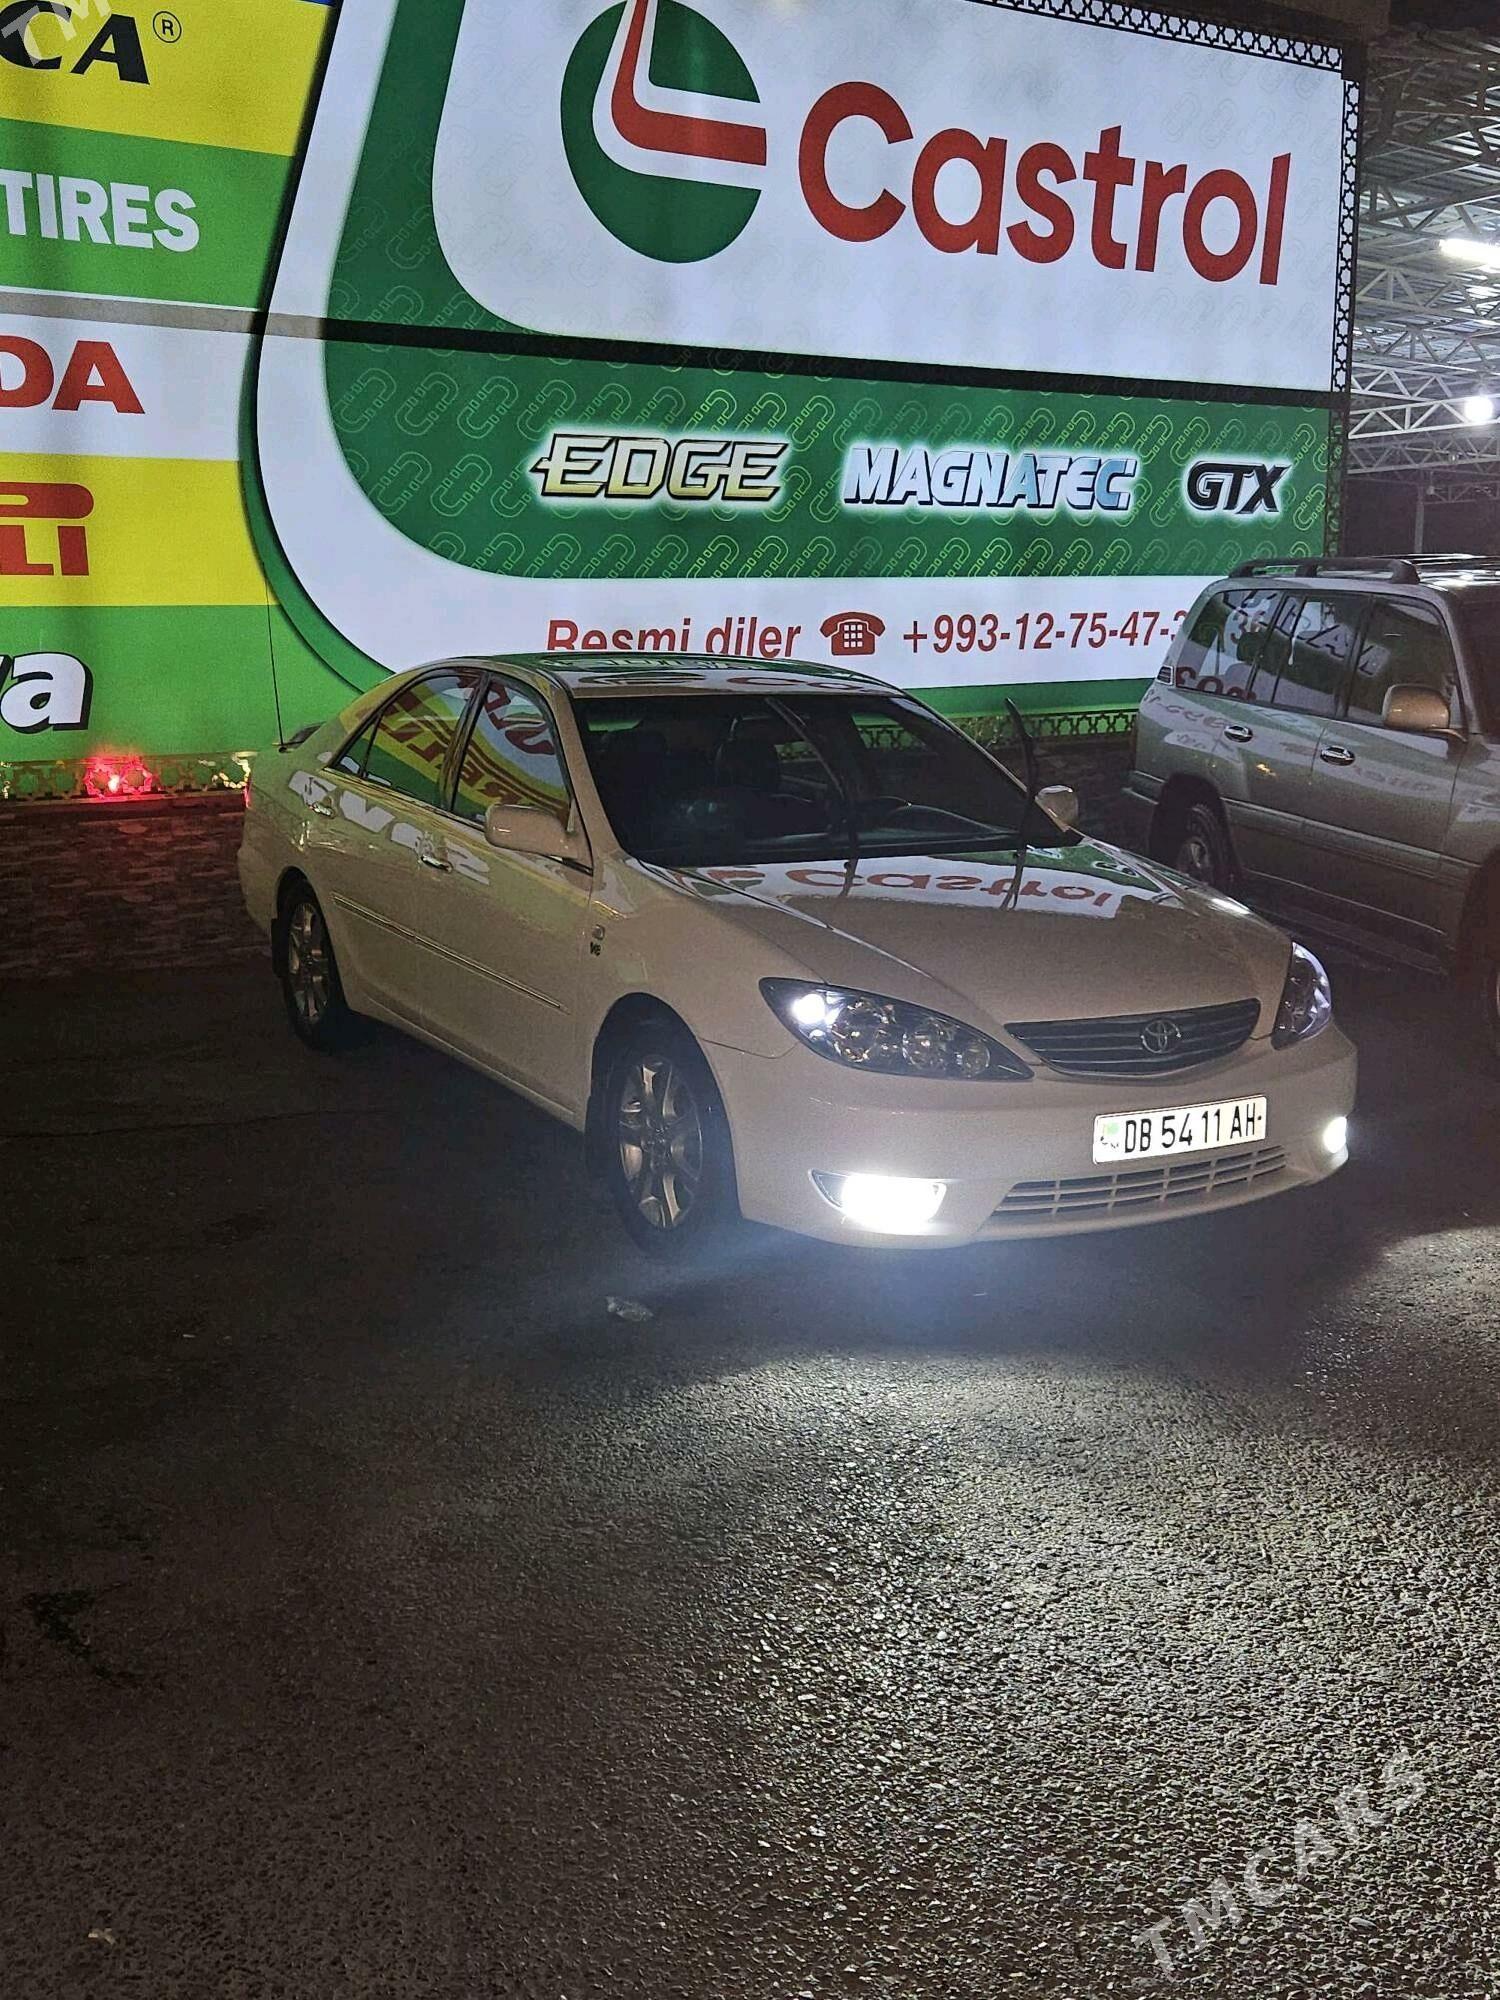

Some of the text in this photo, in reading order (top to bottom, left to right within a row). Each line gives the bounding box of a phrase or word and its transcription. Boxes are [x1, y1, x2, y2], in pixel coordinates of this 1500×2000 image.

[0, 168, 200, 252] TIRES
[799, 81, 1291, 285] Castrol
[529, 433, 789, 501] EDGE
[843, 447, 1138, 510] MAGNATEC
[1187, 460, 1292, 514] GTX
[547, 617, 691, 651] Resmi
[705, 616, 801, 659] diler
[0, 651, 94, 734] a
[1125, 1102, 1256, 1153] DB 54 11 AH
